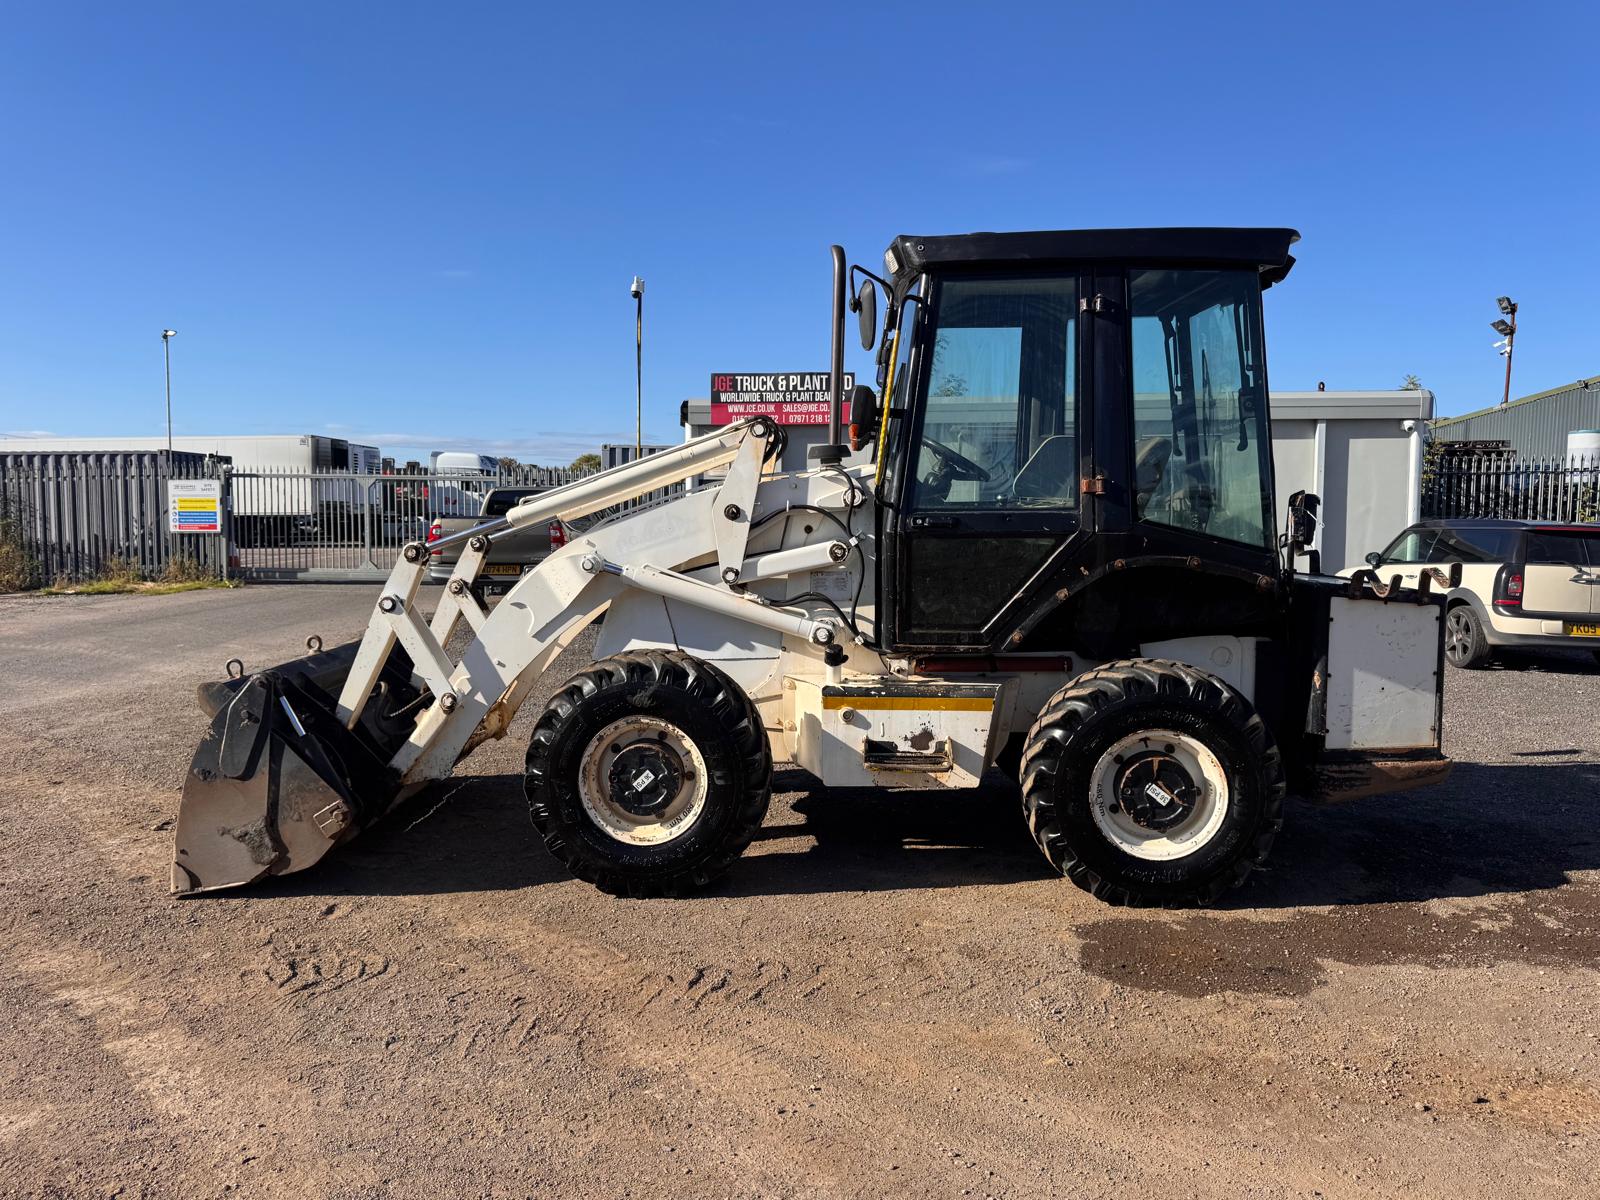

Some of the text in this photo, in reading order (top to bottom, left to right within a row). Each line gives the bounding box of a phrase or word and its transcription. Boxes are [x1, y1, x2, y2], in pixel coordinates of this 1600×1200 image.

[713, 375, 733, 391] JGE
[735, 375, 775, 391] TRUCK
[778, 375, 787, 391] &
[789, 375, 828, 391] PLANT
[720, 392, 761, 402] WORLDWIDE
[762, 392, 784, 402] TRUCK
[785, 391, 791, 402] &
[792, 391, 814, 402] PLANT
[788, 414, 809, 424] 07971
[810, 414, 823, 423] 218
[1569, 623, 1597, 634] YK09
[634, 779, 646, 790] PSI
[1149, 786, 1160, 797] PSI
